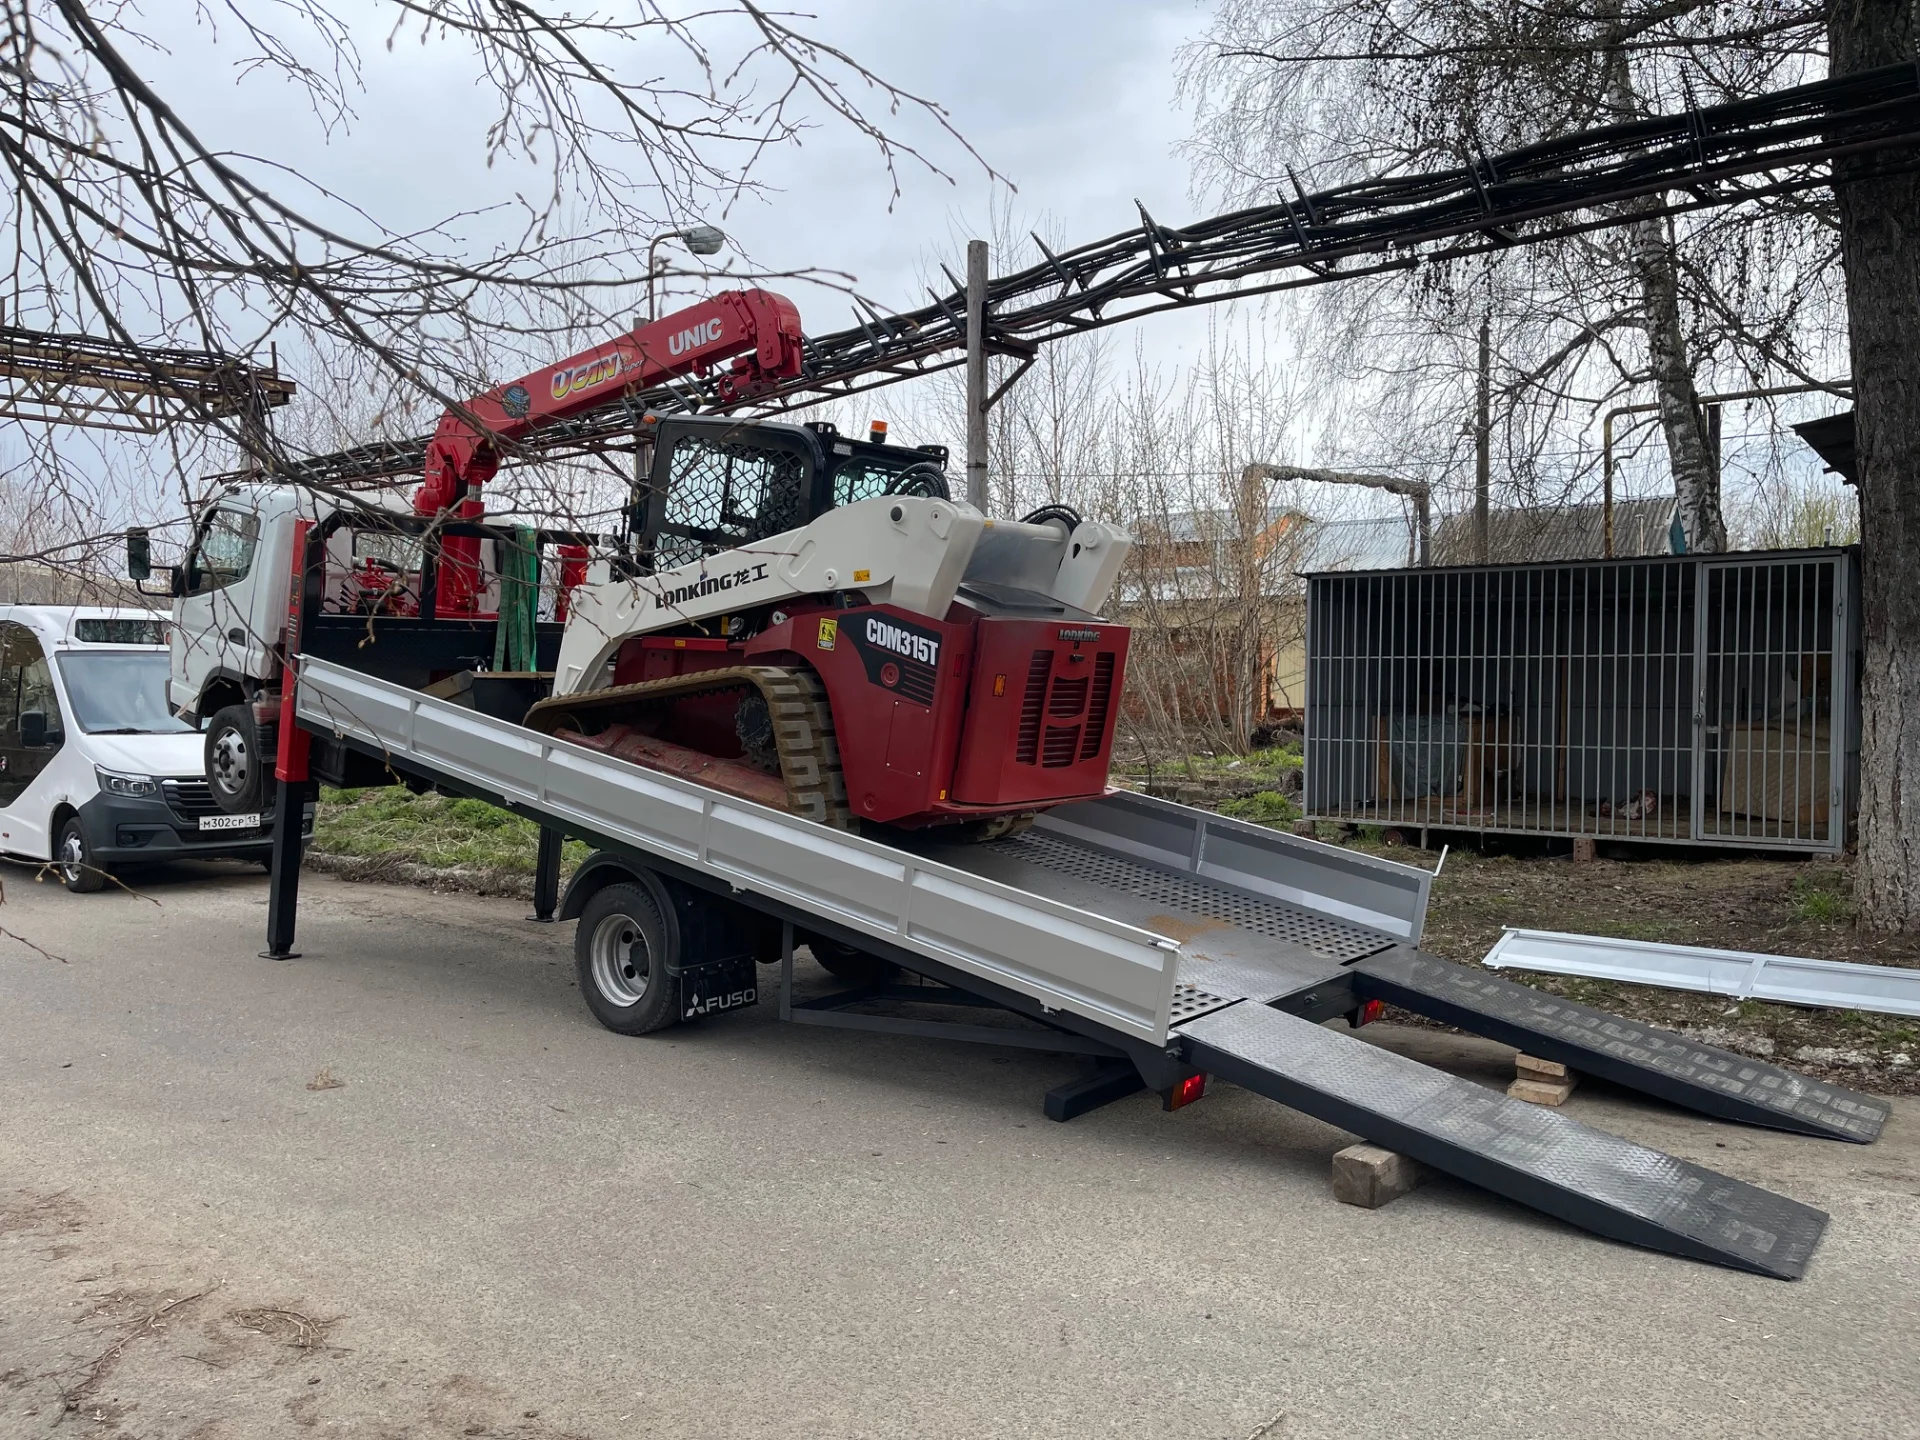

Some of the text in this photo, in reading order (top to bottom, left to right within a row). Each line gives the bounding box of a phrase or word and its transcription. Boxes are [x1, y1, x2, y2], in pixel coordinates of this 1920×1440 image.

[668, 317, 723, 356] UNIC
[866, 618, 939, 666] CDM315T
[706, 988, 756, 1012] FUSO
